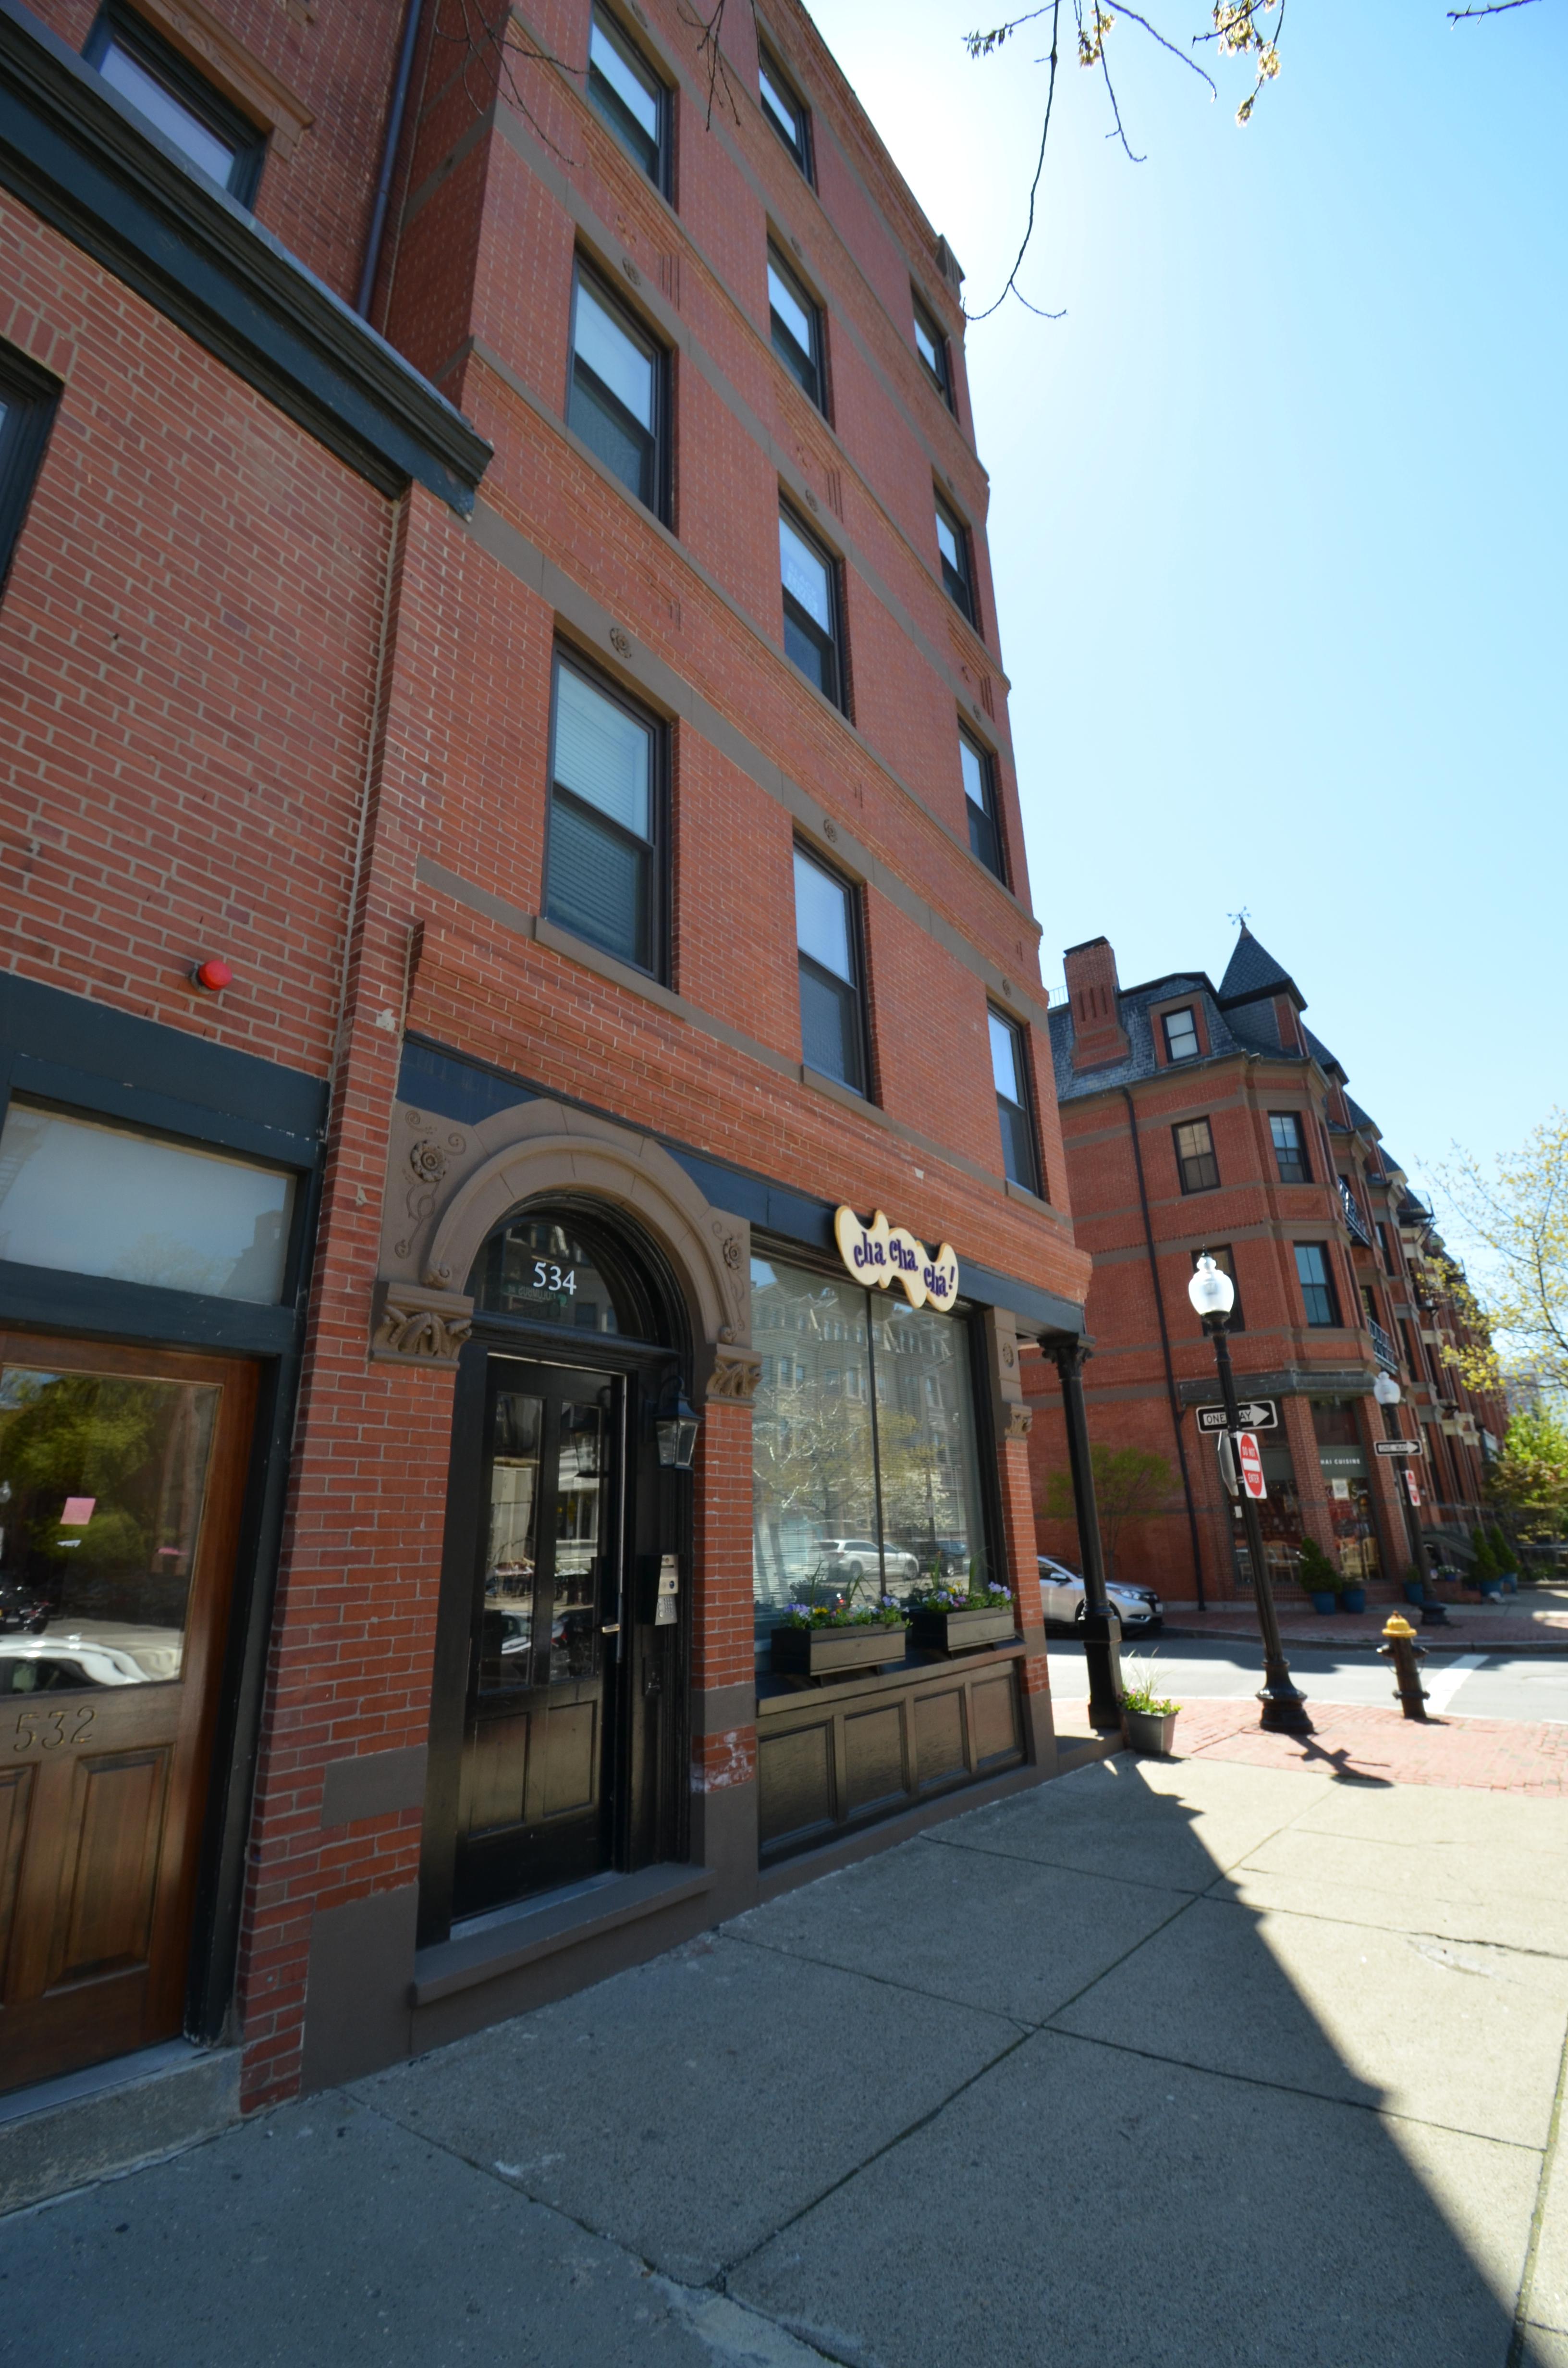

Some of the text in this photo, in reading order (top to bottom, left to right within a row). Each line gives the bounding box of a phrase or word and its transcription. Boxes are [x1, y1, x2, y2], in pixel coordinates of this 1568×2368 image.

[854, 1231, 956, 1297] cha cha chá!
[533, 1262, 576, 1295] 534
[1206, 1411, 1251, 1424] ONE AY
[1242, 1446, 1248, 1456] DO
[1248, 1473, 1260, 1483] ENTER
[13, 1705, 97, 1752] 532
